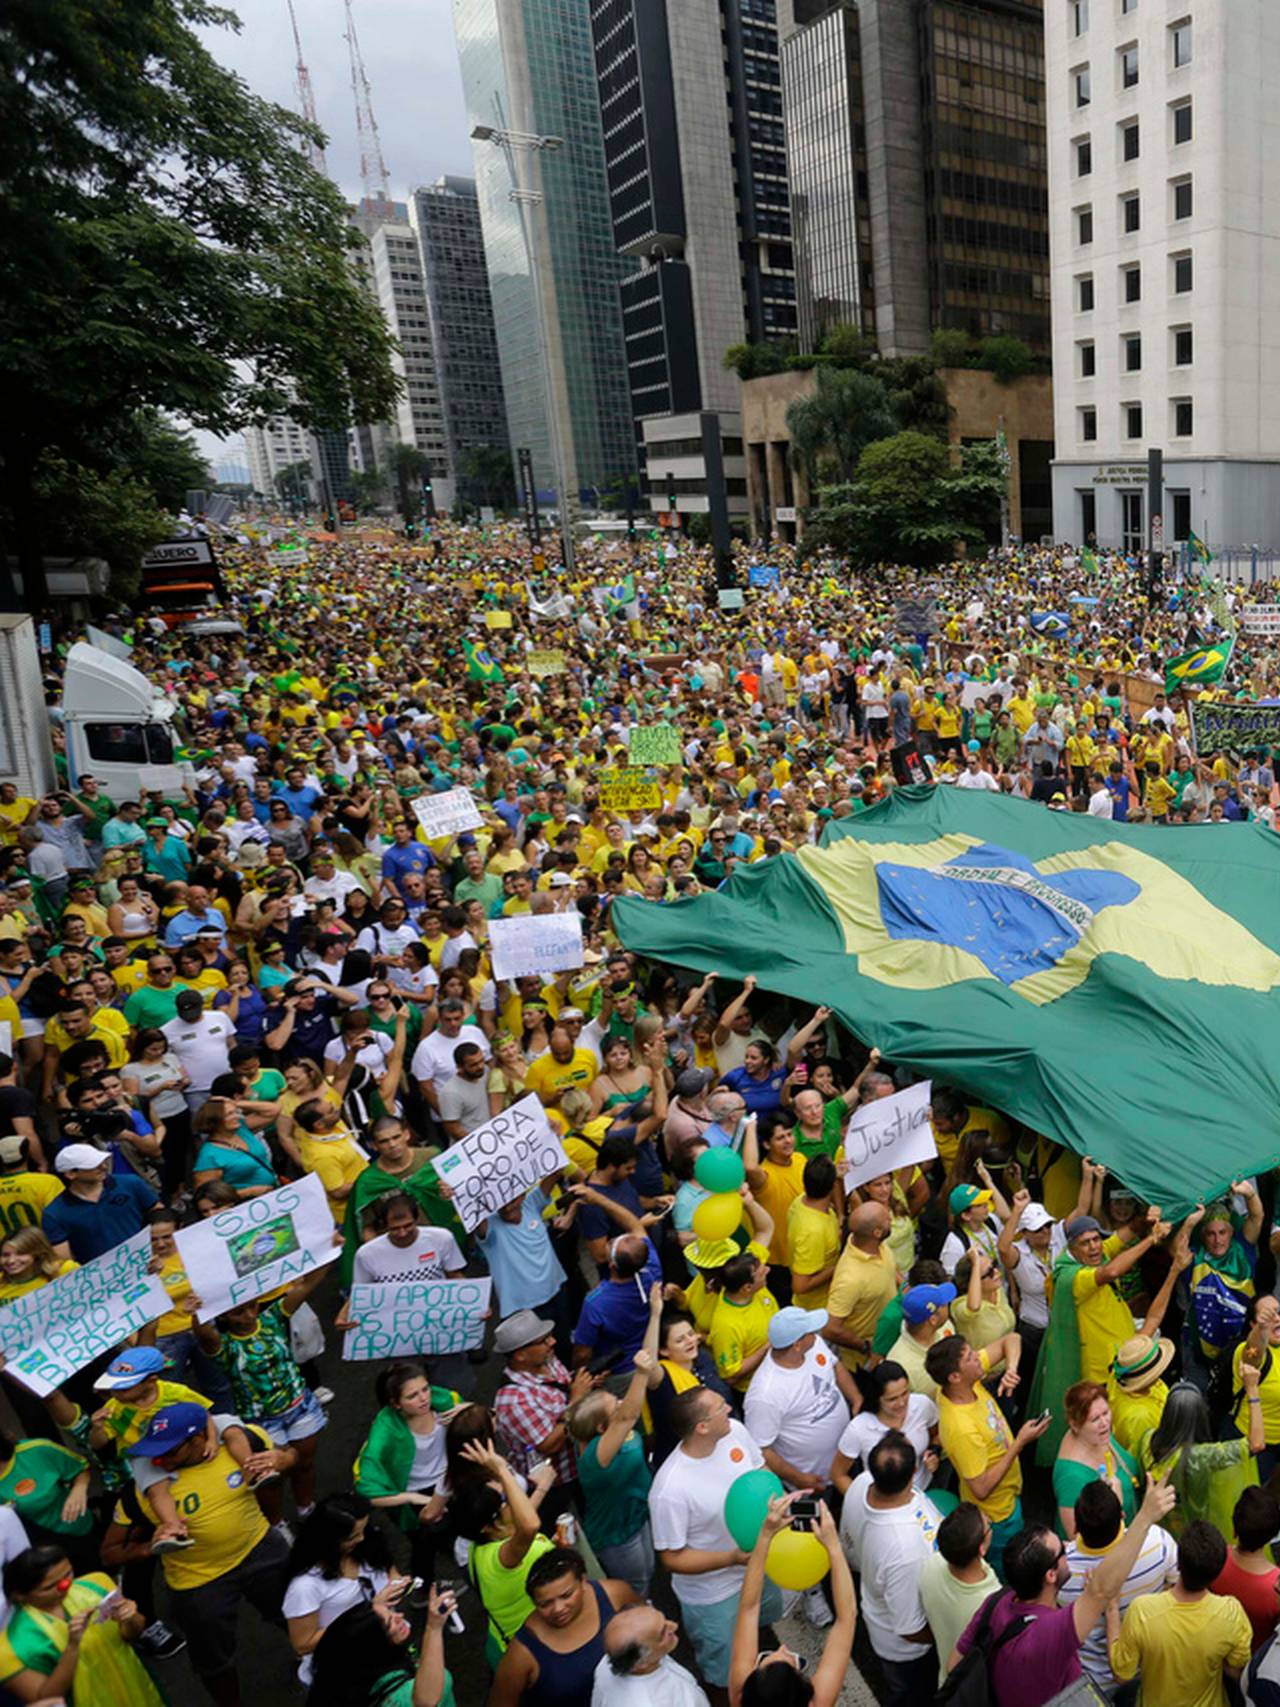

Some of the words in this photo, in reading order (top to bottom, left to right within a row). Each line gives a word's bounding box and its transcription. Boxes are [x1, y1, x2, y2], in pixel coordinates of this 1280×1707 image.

[461, 1109, 535, 1167] FORA
[451, 1155, 513, 1207] FORO
[514, 1129, 542, 1162] DE
[497, 1147, 559, 1203] PAULO
[228, 1249, 317, 1305] FFAA
[352, 1286, 386, 1311] EU
[395, 1282, 481, 1307] APOIO
[37, 1305, 151, 1388] BRASIL
[45, 1305, 111, 1357] PELO
[351, 1328, 484, 1360] ARMADAS
